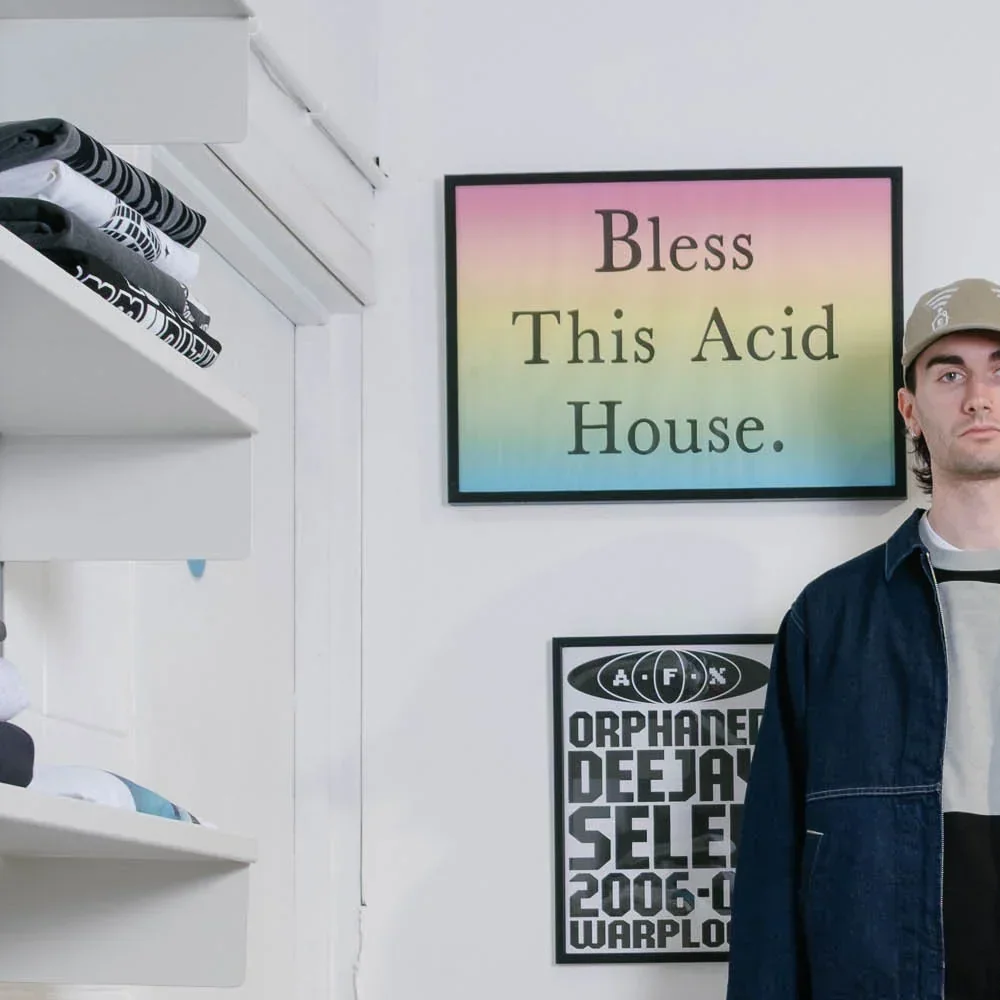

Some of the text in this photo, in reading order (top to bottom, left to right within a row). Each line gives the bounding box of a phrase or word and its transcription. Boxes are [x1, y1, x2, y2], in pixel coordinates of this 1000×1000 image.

[594, 209, 754, 273] Bless
[511, 304, 839, 365] This Acid
[567, 400, 784, 455] House.
[570, 918, 731, 949] WARPLO
